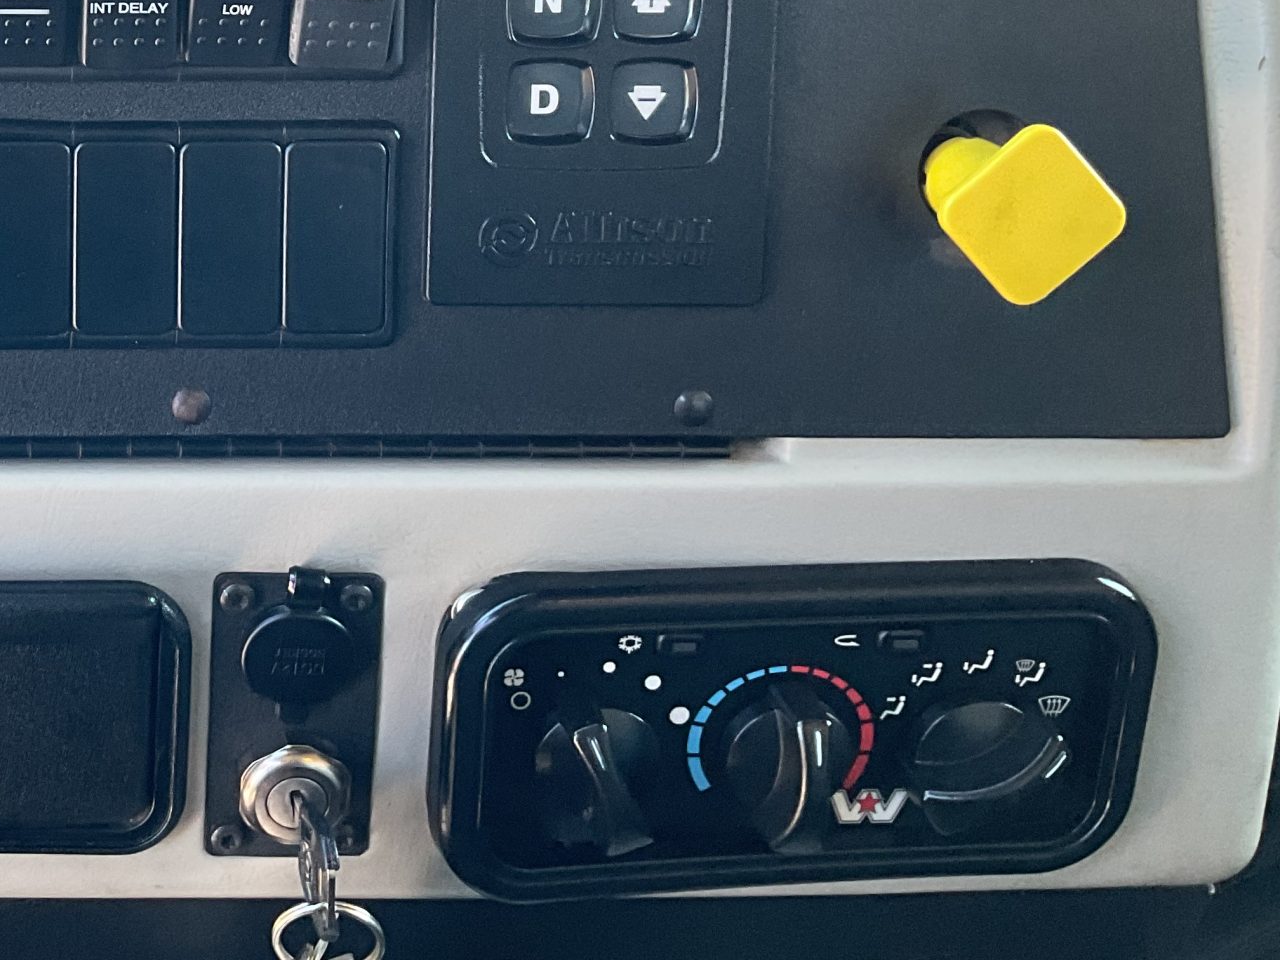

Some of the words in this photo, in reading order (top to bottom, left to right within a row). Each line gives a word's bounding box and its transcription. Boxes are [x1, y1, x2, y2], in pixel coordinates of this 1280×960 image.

[89, 2, 116, 14] INT
[118, 2, 169, 14] DELAY
[222, 3, 254, 16] LOW
[530, 83, 560, 115] D
